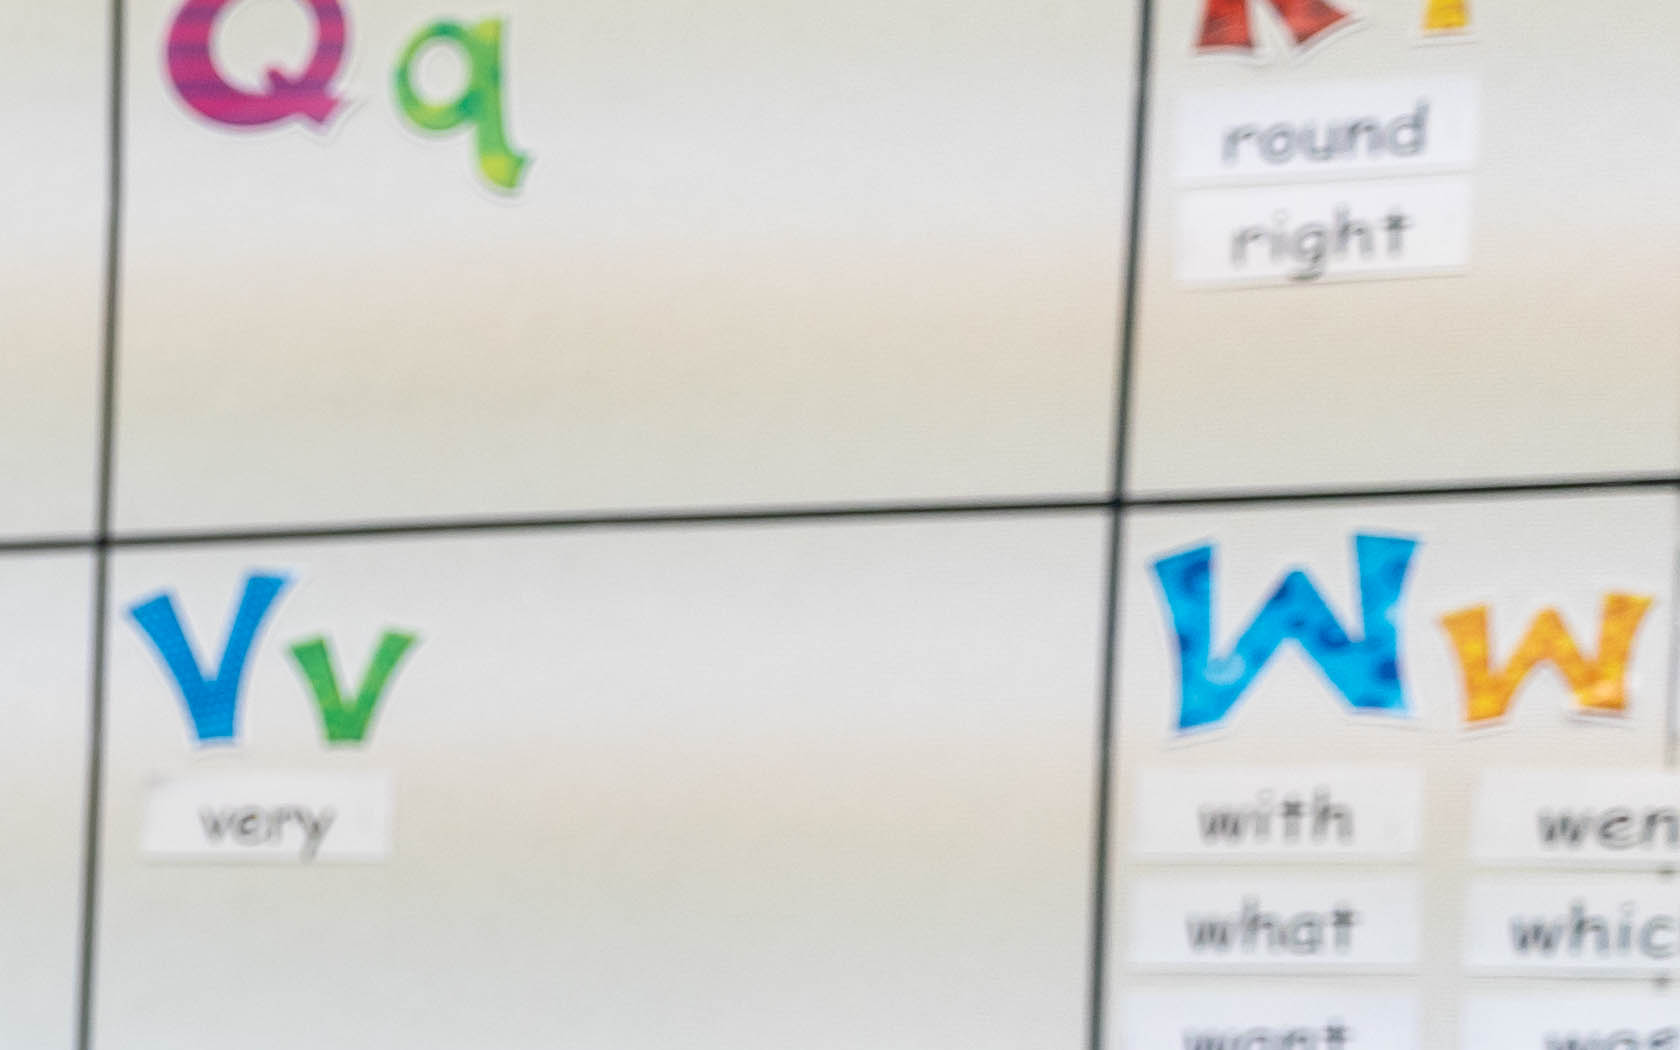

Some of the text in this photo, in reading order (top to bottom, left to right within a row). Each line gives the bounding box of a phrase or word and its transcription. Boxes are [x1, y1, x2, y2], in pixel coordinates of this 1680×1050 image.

[1221, 98, 1431, 166] round
[1230, 206, 1411, 281] right
[200, 804, 337, 863] very
[1197, 786, 1354, 845] with
[1537, 806, 1680, 849] wen
[1185, 898, 1357, 955] what
[1509, 902, 1680, 960] whic
